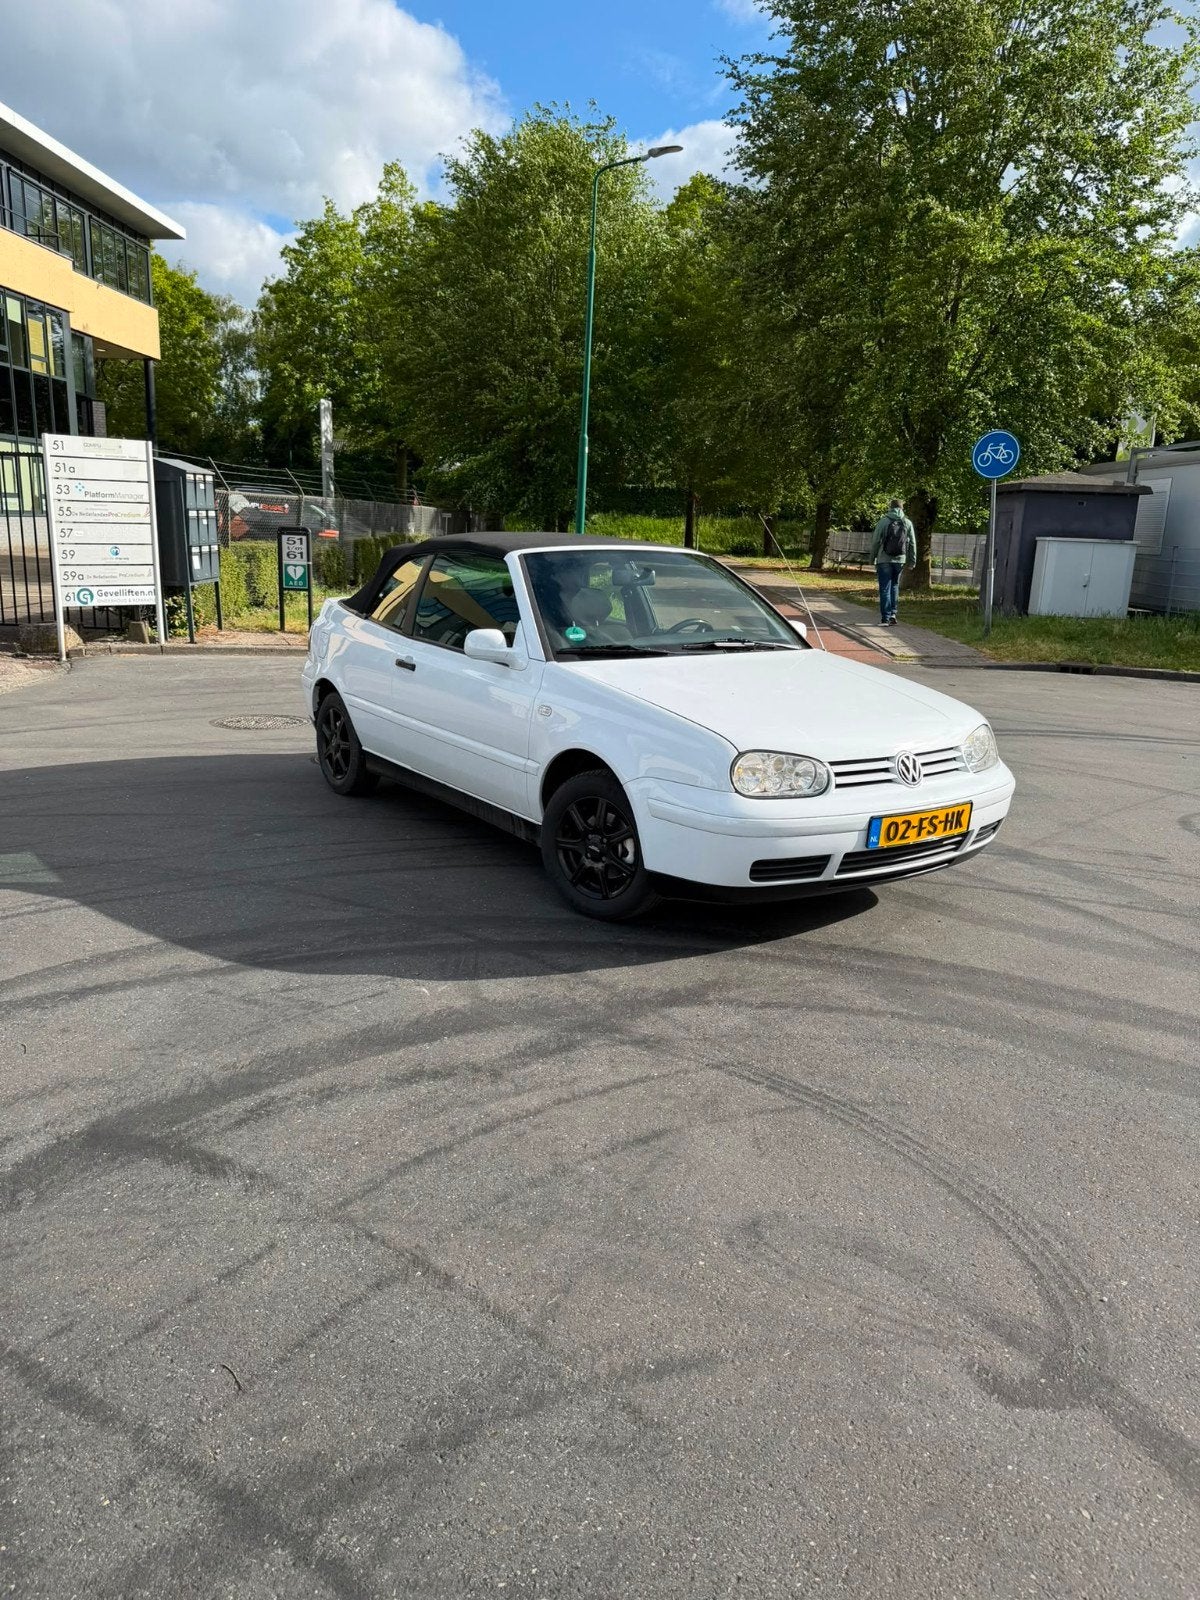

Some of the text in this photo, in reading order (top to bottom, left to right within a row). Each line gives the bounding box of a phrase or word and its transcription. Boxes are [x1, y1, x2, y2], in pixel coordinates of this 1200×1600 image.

[52, 440, 64, 451] 51
[54, 463, 76, 473] 51a
[56, 484, 71, 495] 53
[84, 491, 143, 500] PlatformManager
[57, 506, 72, 517] 55
[59, 528, 73, 538] 57
[286, 537, 303, 546] 51
[61, 550, 75, 559] 59
[287, 551, 303, 559] 61
[62, 571, 84, 580] 59a
[64, 592, 75, 601] 61
[97, 589, 156, 597] Gevelliften.nl
[885, 809, 965, 842] 02-FS-HK
